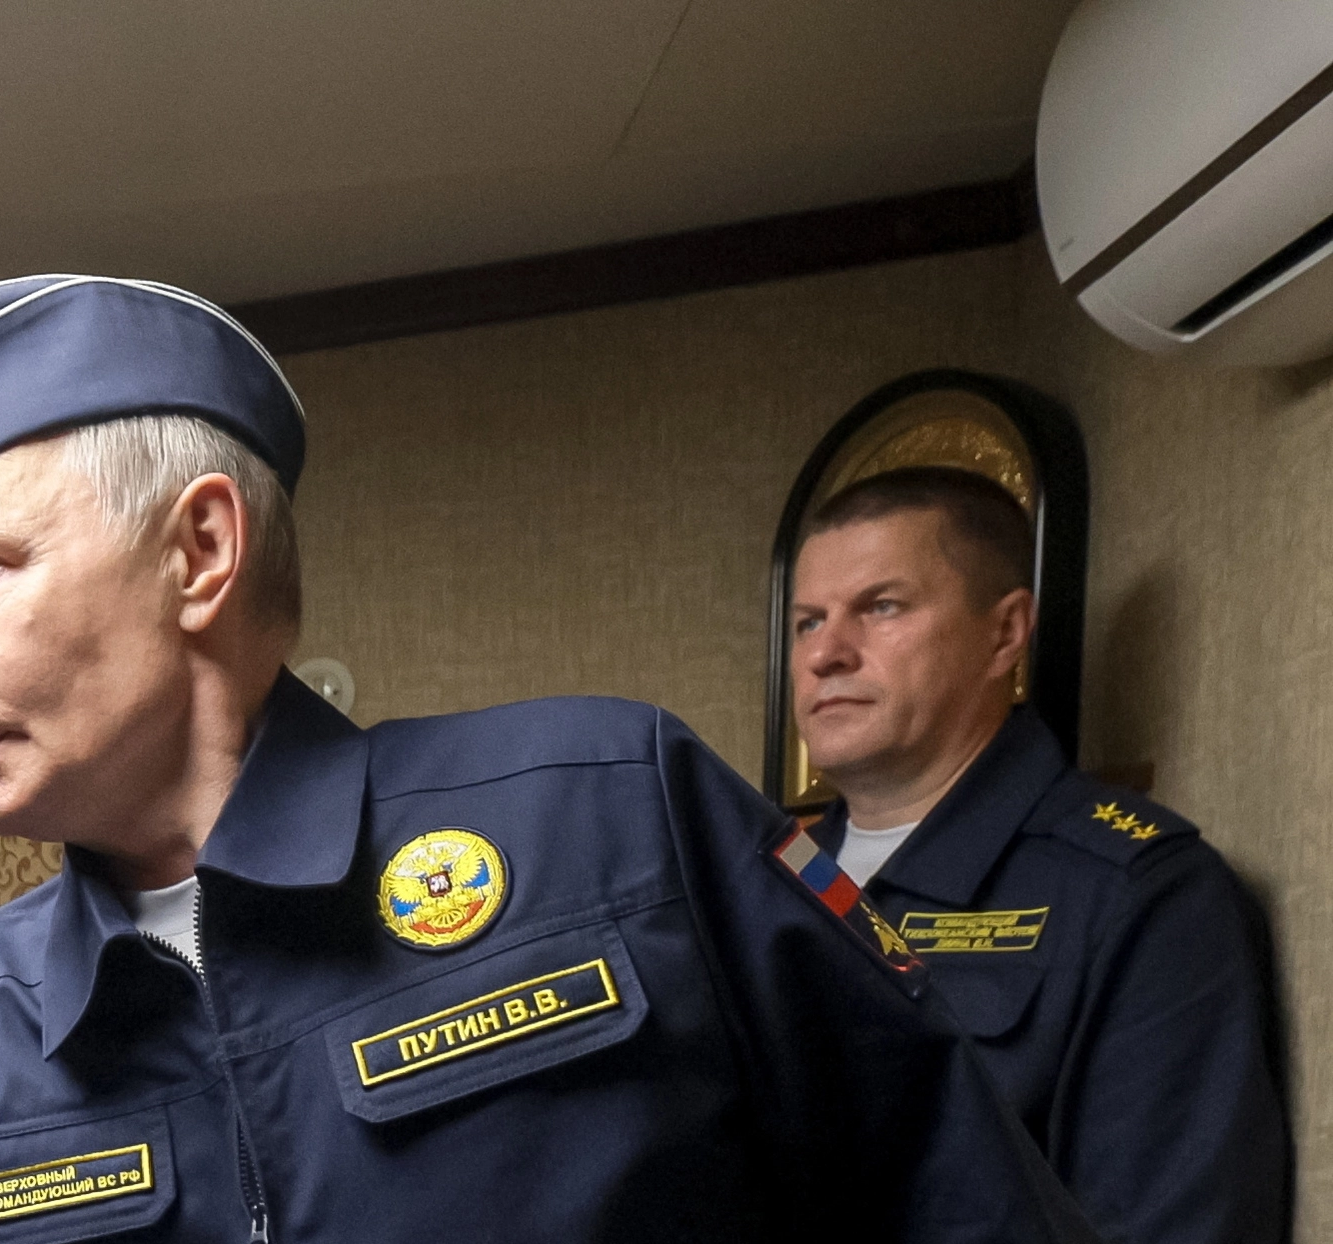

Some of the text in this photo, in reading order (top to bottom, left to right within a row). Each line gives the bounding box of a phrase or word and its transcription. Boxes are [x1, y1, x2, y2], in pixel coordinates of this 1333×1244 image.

[397, 988, 569, 1061] ПУТИН В.В.
[97, 1173, 117, 1189] ВС
[119, 1168, 141, 1185] РФ
